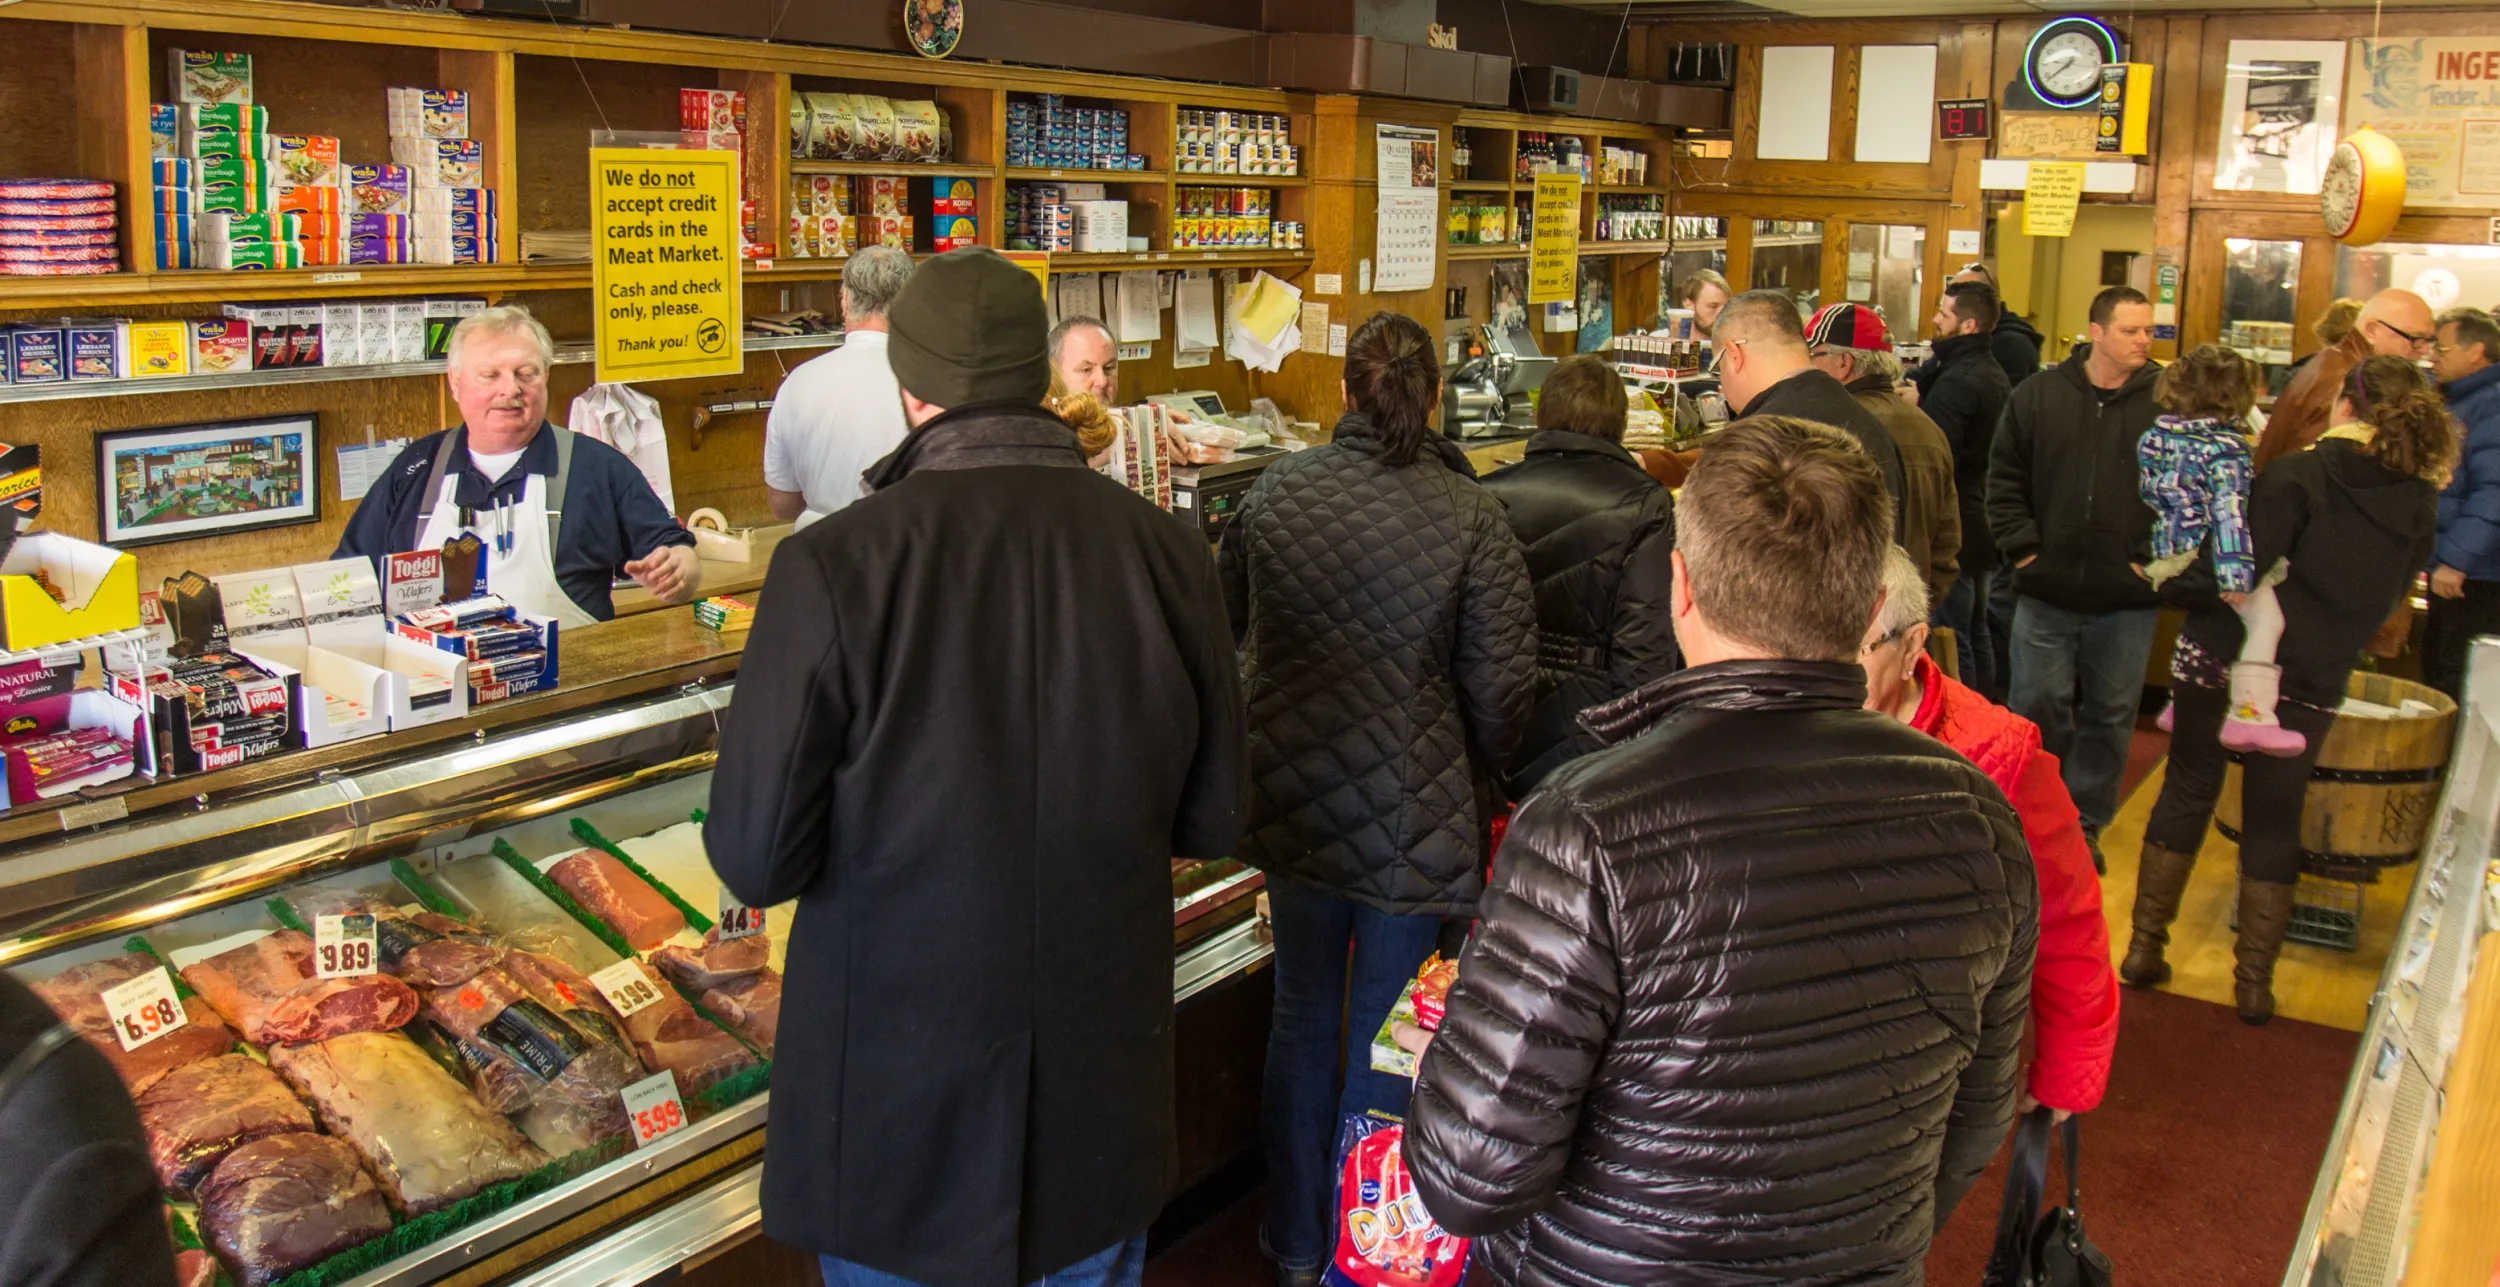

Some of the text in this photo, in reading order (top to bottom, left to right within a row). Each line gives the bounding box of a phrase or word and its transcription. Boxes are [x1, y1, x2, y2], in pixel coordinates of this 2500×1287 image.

[186, 50, 213, 61] wasa
[424, 91, 445, 100] wasa
[160, 120, 175, 129] rye
[281, 136, 307, 146] wasa
[439, 140, 461, 151] wasa
[311, 149, 337, 159] hearty
[352, 167, 377, 177] wasa
[605, 168, 696, 187] We do not
[1539, 184, 1568, 195] We do not
[607, 195, 717, 216] accept credit
[952, 199, 973, 207] KORNI
[1539, 200, 1557, 211] accept
[1538, 213, 1553, 224] cards
[1553, 213, 1560, 223] in
[607, 219, 708, 239] cards in the
[1537, 228, 1552, 238] Meat
[952, 237, 973, 245] KORNI
[608, 245, 724, 265] Meat Market.
[1536, 248, 1548, 256] Cash
[1549, 247, 1559, 256] and
[609, 278, 722, 298] Cash and check
[609, 300, 703, 322] only, please.
[199, 324, 225, 333] wasa
[617, 334, 689, 352] Thank you!
[394, 554, 437, 579] Toggi
[475, 578, 485, 586] 24
[396, 583, 433, 602] Wafers
[268, 607, 291, 621] Salty
[213, 624, 224, 632] 24
[0, 668, 58, 689] NATURAL
[510, 677, 539, 694] Wafers
[13, 684, 53, 698] Licorice
[480, 686, 505, 701] Toggi
[249, 690, 286, 709] Toggi
[204, 699, 245, 718] Wafers
[243, 738, 280, 757] Wafers
[207, 747, 239, 767] Toggi
[720, 906, 761, 933] $4.49
[318, 941, 370, 972] $9.89
[115, 997, 177, 1042] $6.98
[519, 1039, 554, 1075] PRIME
[642, 1086, 656, 1097] BACK
[630, 1098, 681, 1140] $5.99
